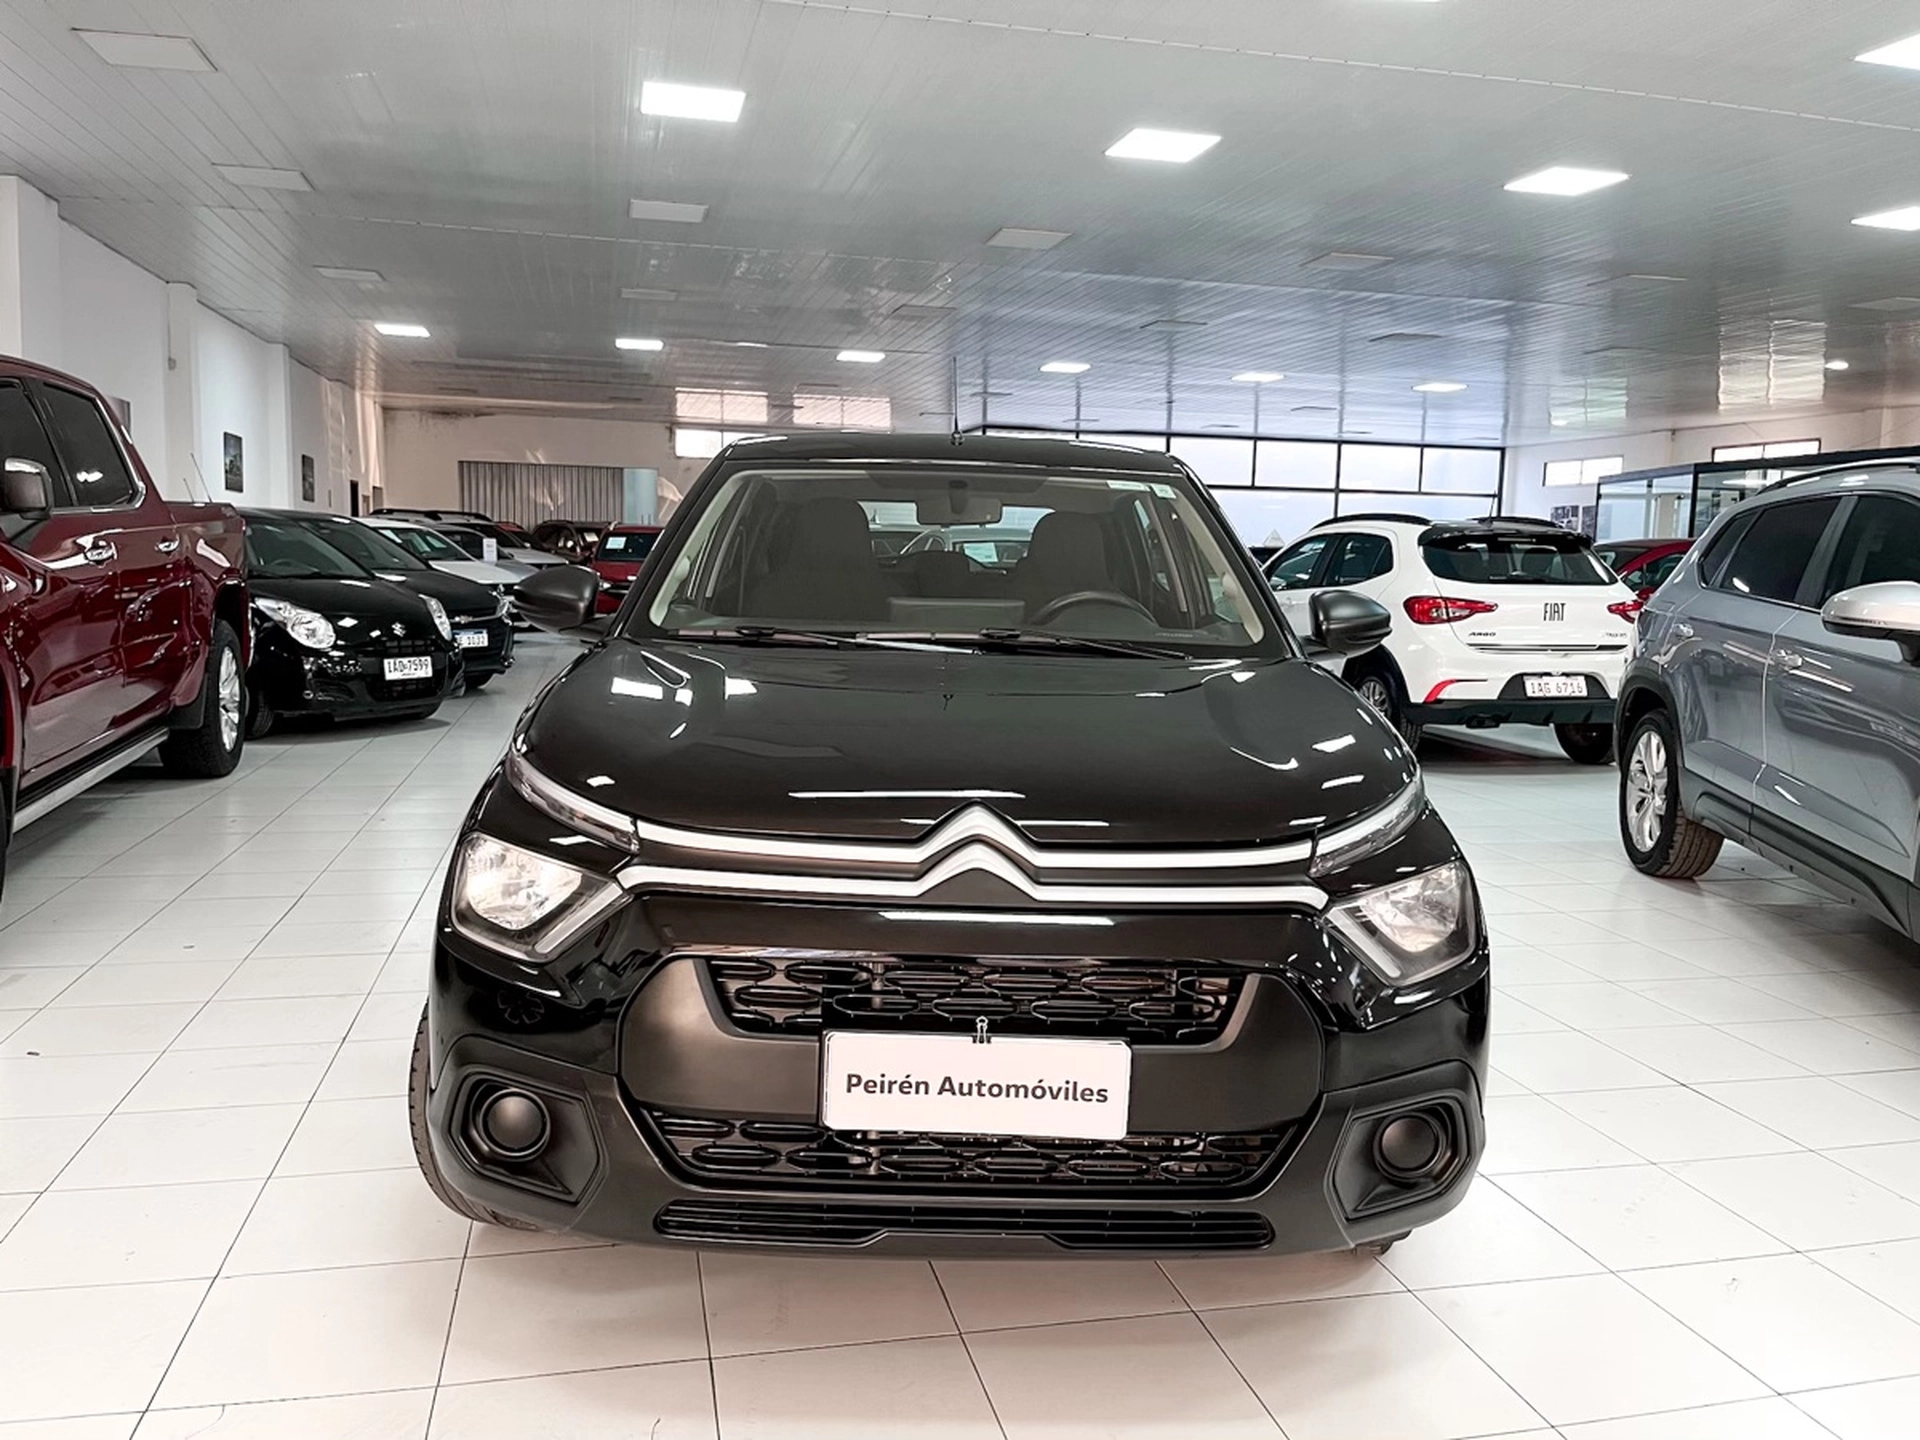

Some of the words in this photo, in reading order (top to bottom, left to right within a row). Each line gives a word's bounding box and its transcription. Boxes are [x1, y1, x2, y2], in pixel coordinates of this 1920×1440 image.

[1543, 603, 1566, 621] FIAT
[846, 1073, 930, 1095] Peirén
[937, 1076, 1109, 1103] Automóviles
